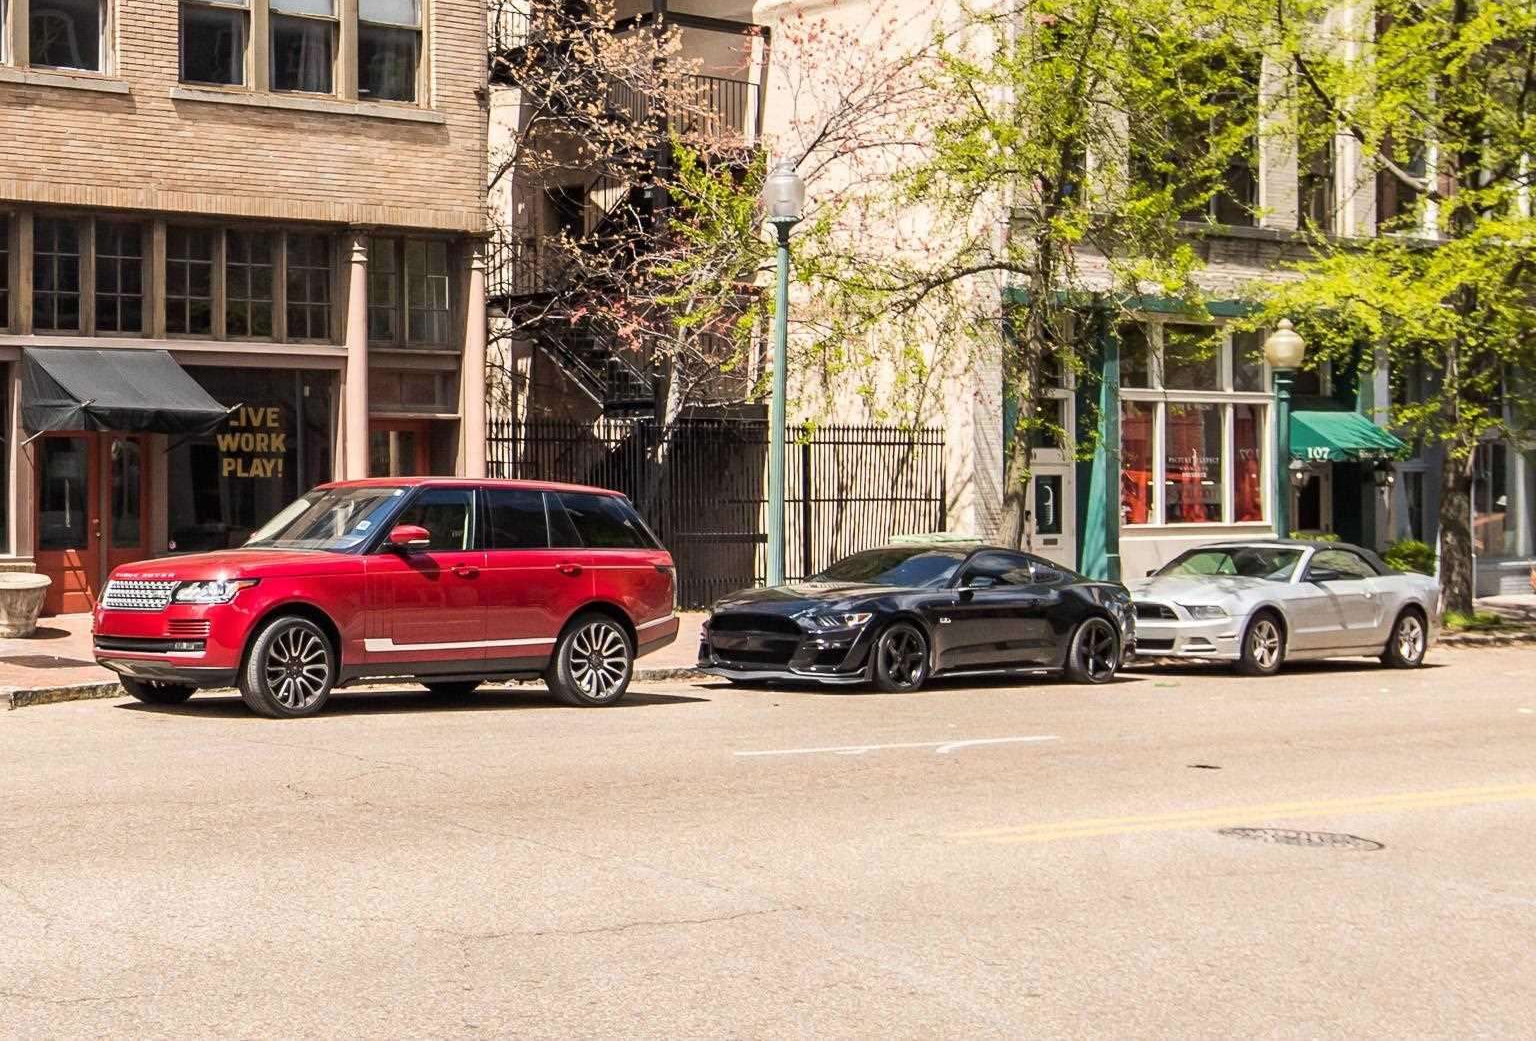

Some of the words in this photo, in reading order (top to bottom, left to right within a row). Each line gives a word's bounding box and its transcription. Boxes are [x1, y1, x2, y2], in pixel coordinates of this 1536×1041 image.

[216, 433, 287, 452] WORK
[1307, 446, 1331, 460] 107
[222, 458, 284, 477] PLAY!
